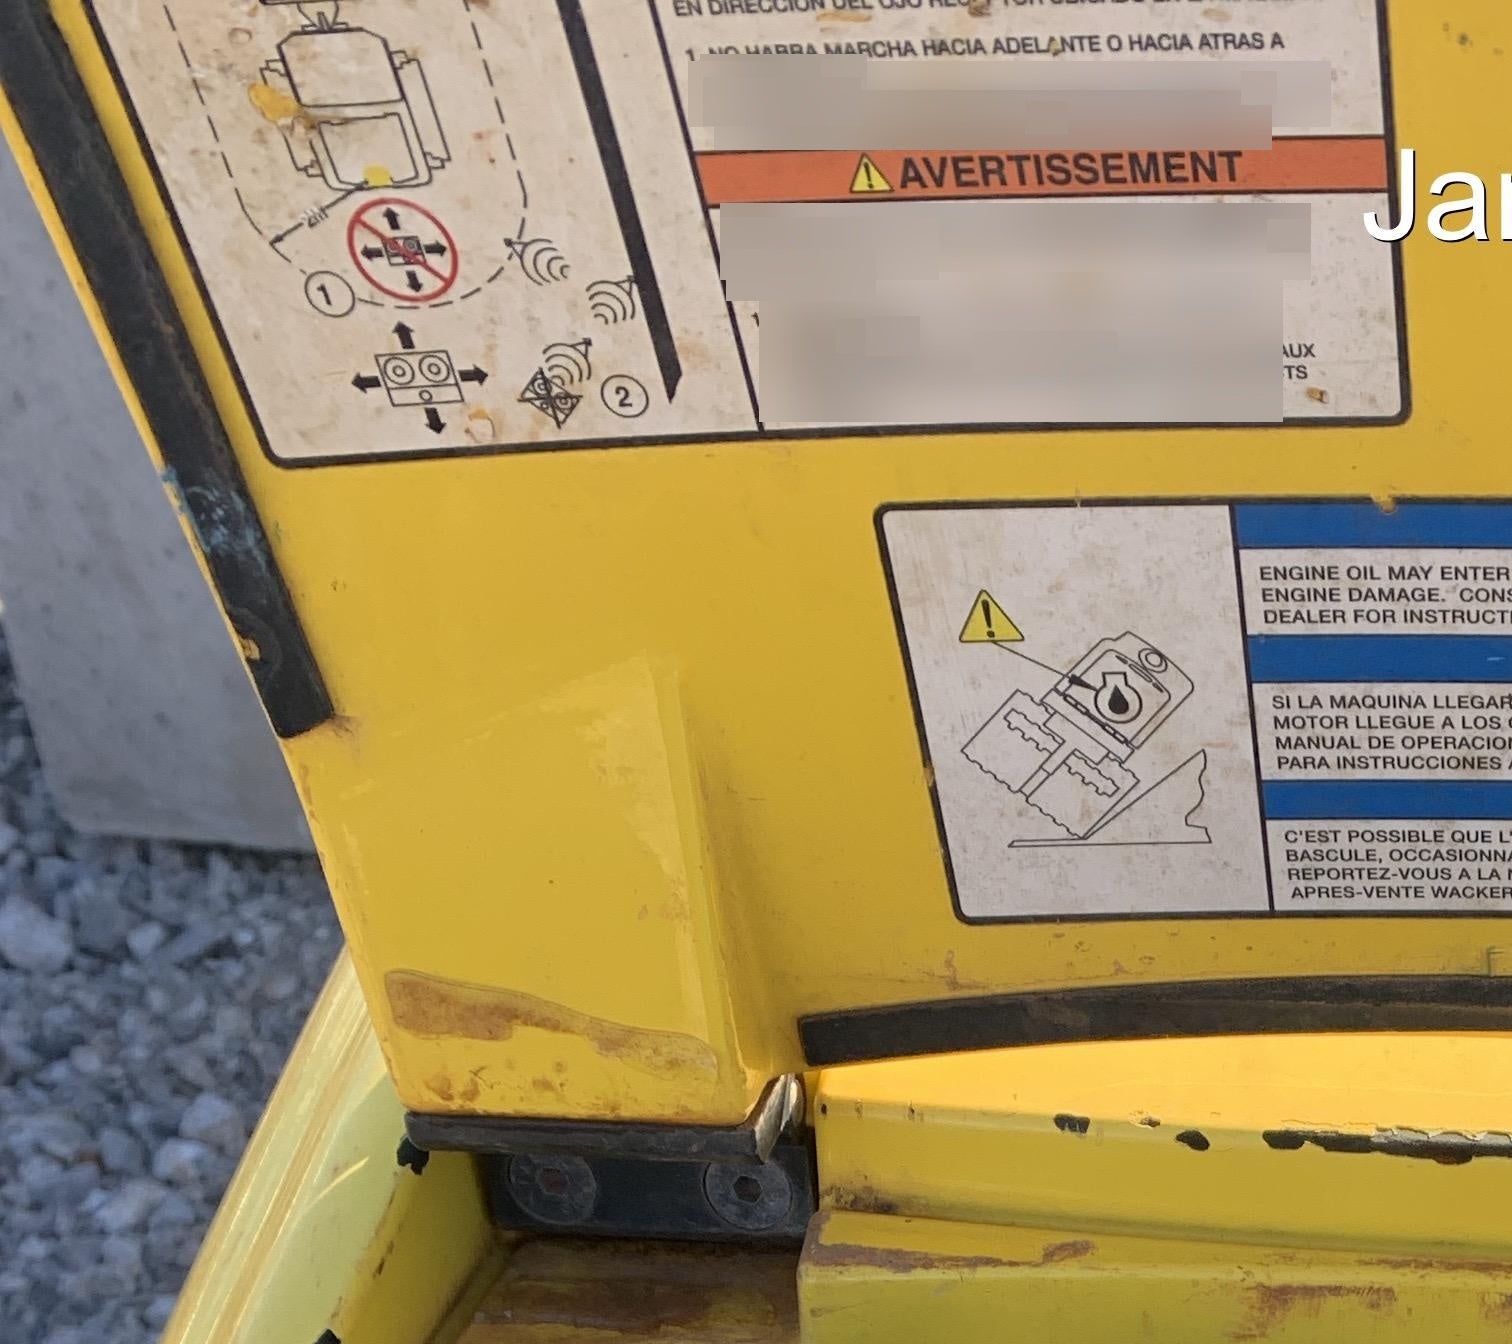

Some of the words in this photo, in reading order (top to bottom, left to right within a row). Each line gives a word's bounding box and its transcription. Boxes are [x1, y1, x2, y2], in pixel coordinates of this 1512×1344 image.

[921, 37, 986, 55] HACIA
[992, 36, 1101, 55] ADELANTE
[1107, 35, 1122, 51] O
[1129, 33, 1191, 51] HACIA
[1198, 32, 1264, 50] ATRAS
[1270, 32, 1285, 49] A
[900, 151, 1243, 189] AVERTISSEMENT
[317, 283, 330, 306] 1
[615, 384, 633, 410] 2
[1259, 566, 1340, 581] ENGINE
[1346, 565, 1381, 580] OIL
[1388, 565, 1433, 580] MAY
[1440, 566, 1510, 581] ENTER
[1262, 588, 1341, 602] ENGINE
[1348, 588, 1445, 602] DAMAGE.
[1264, 610, 1346, 624] DEALER
[1353, 609, 1396, 623] FOR
[1272, 696, 1291, 709] SI
[1298, 695, 1323, 709] LA
[1330, 695, 1427, 709] MAQUINA
[1273, 715, 1348, 730] MOTOR
[1356, 715, 1435, 729] LLEGUE
[1441, 716, 1455, 729] A
[1462, 716, 1501, 730] LOS
[1275, 736, 1361, 750] MANUAL
[1368, 736, 1395, 749] DE
[1277, 756, 1330, 769] PARA
[1337, 756, 1502, 770] INSTRUCCIONES
